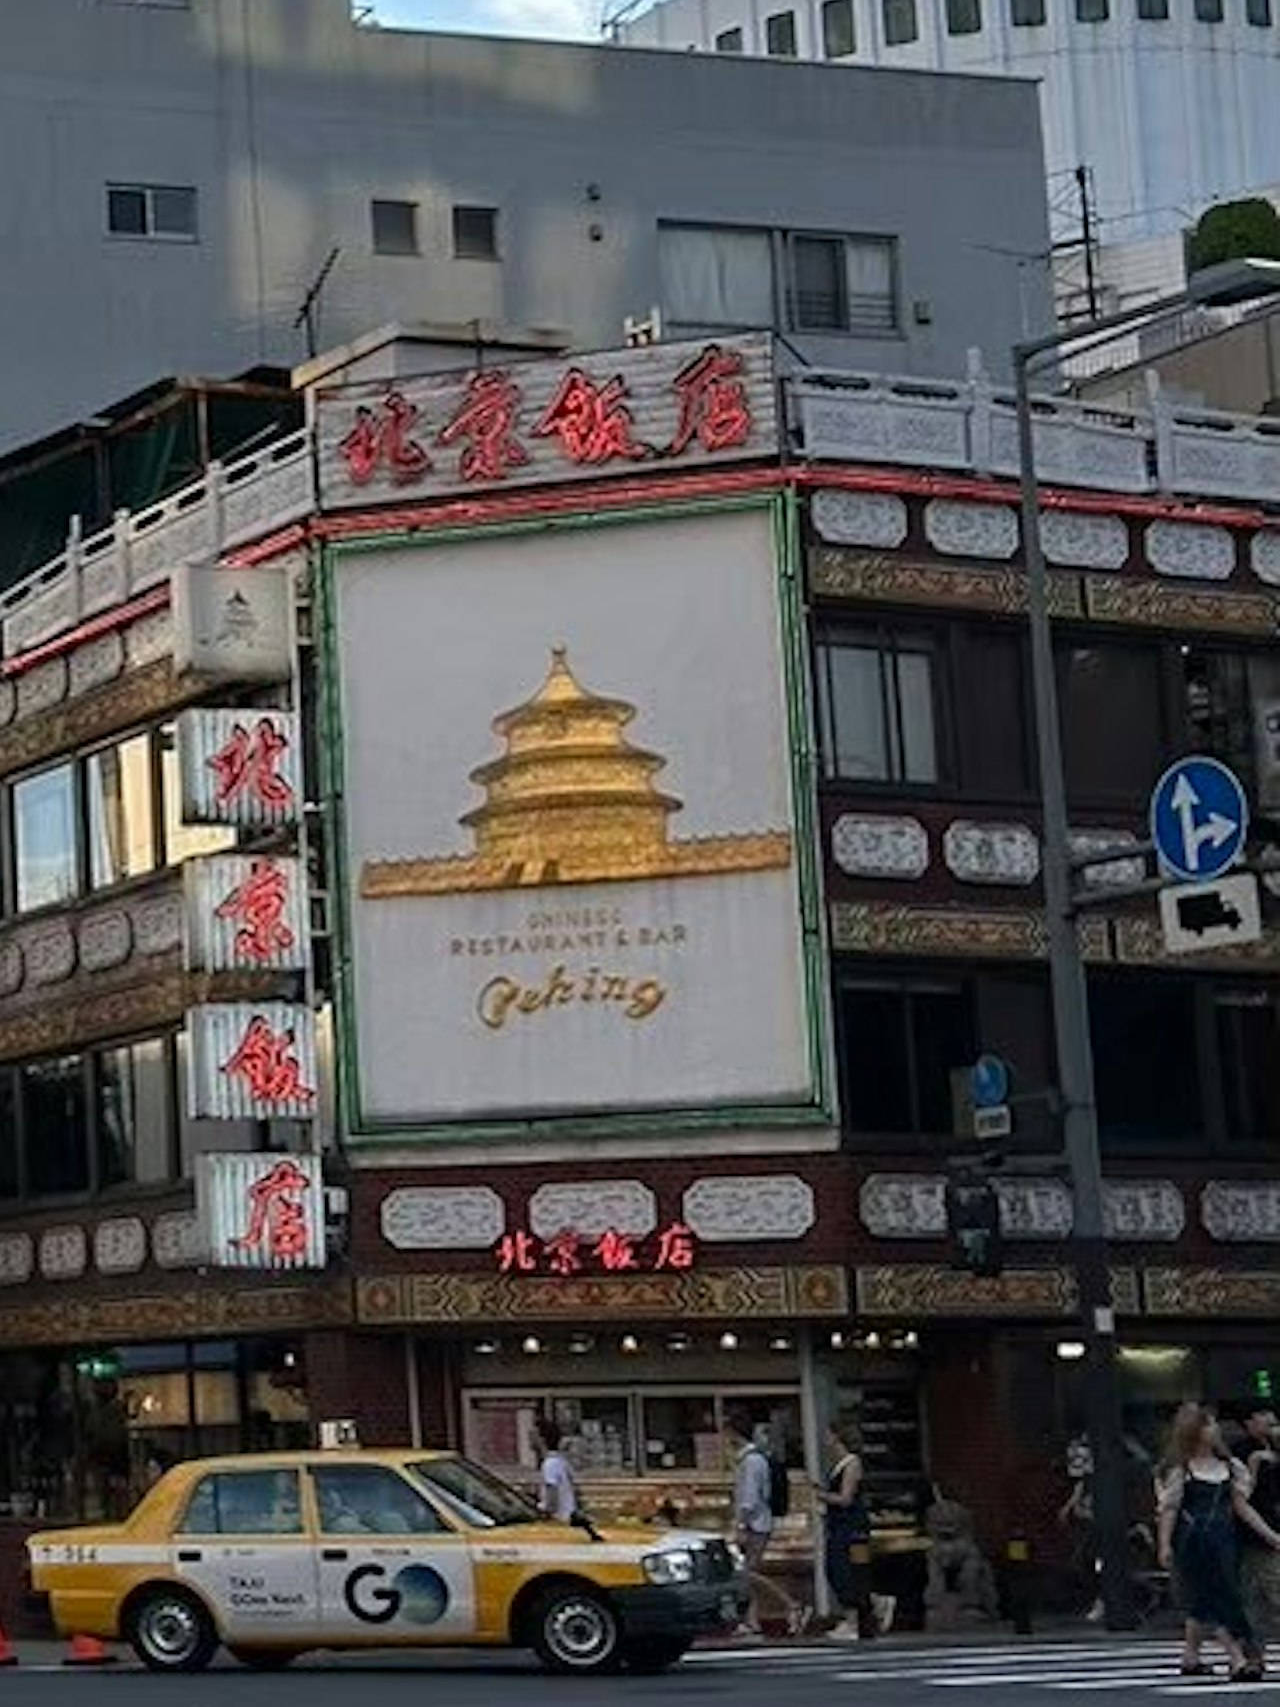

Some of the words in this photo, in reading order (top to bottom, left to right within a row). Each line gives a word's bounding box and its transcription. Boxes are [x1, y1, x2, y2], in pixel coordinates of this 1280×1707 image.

[340, 344, 754, 482] 北京飯店
[449, 930, 604, 956] RESTAURANT
[639, 923, 687, 946] BAR
[526, 906, 622, 931] CHINESE
[208, 715, 318, 1262] 北京飯店
[495, 1224, 698, 1276] 北京飯店
[344, 1561, 450, 1625] GO
